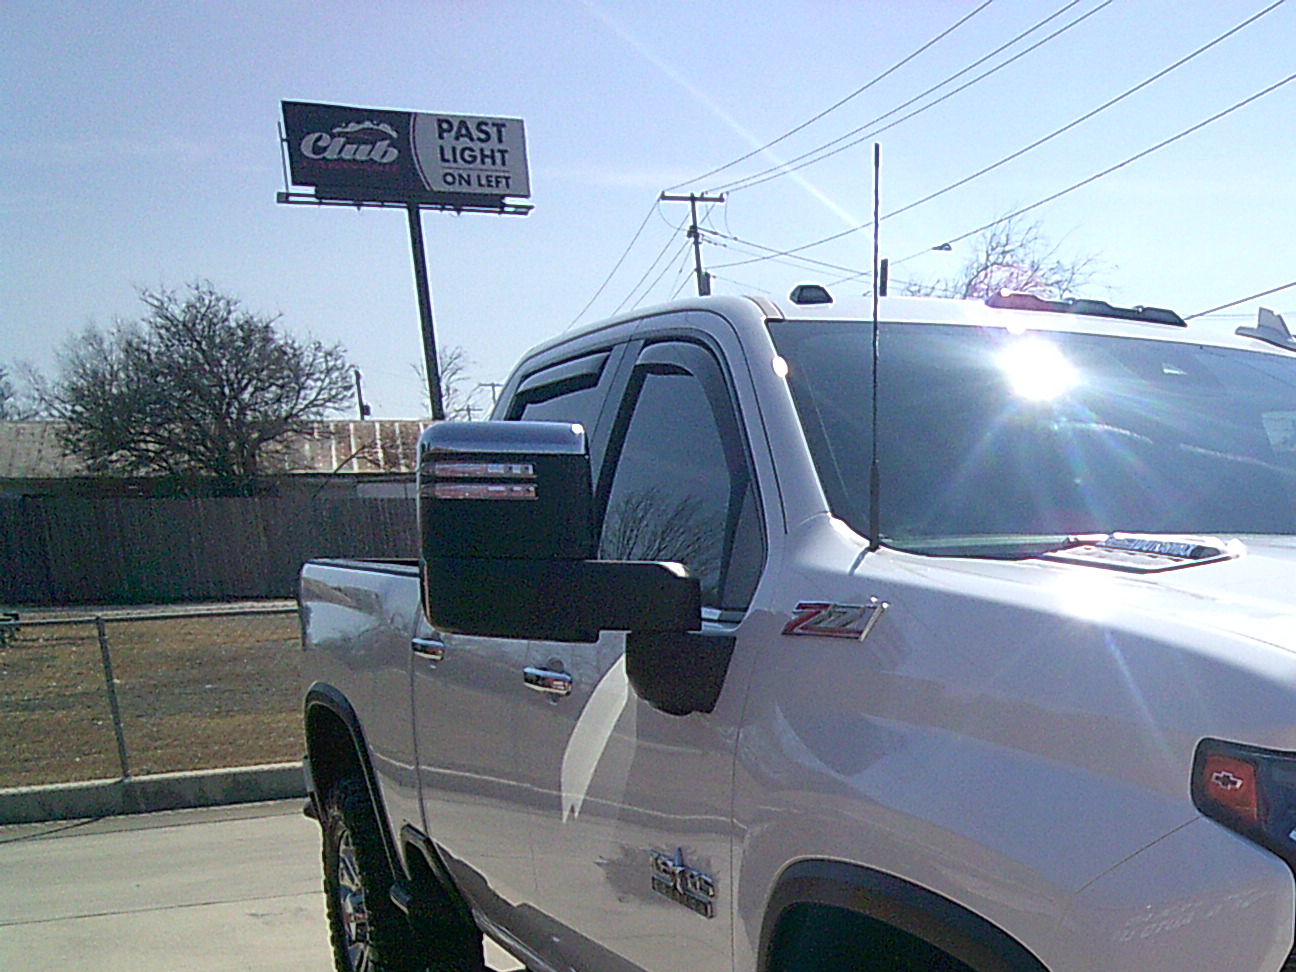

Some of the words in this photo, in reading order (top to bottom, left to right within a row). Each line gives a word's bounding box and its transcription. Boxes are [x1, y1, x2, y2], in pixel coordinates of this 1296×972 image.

[437, 118, 507, 144] PAST
[300, 132, 399, 164] Club
[439, 144, 509, 167] LIGHT
[443, 172, 471, 188] ON
[477, 173, 511, 189] LEFT
